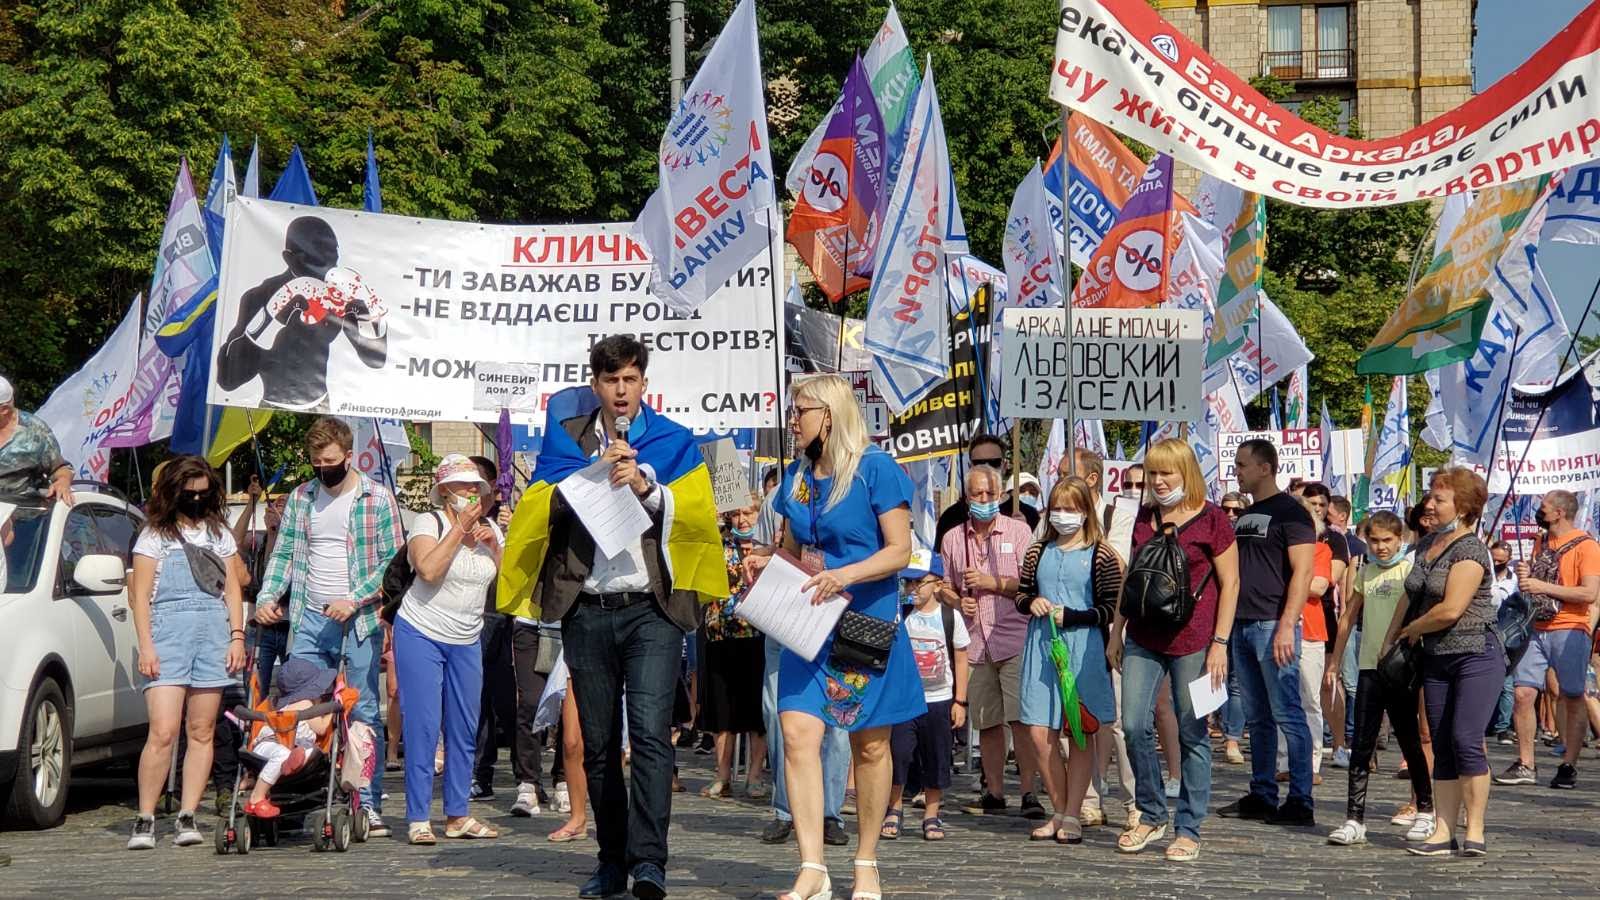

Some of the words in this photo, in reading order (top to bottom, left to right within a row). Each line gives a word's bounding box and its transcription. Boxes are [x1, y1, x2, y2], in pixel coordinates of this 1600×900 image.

[1184, 57, 1281, 134] Банк
[1291, 124, 1468, 163] Аркада,
[1057, 59, 1109, 103] чу
[1113, 88, 1221, 158] жити
[1234, 161, 1256, 181] в
[1273, 180, 1397, 203] своїй
[1177, 87, 1322, 177] більше
[1341, 142, 1476, 183] немає
[1490, 75, 1587, 142] сили
[1074, 125, 1115, 174] КМДА
[512, 236, 648, 264] КЛИЧК
[403, 267, 451, 289] -ТИ
[460, 271, 600, 293] ЗАВАЖАВ
[400, 298, 450, 320] -НЕ
[460, 302, 599, 326] ВІДДАЄШ
[587, 330, 776, 352] ІЕСТОРІВ?
[1089, 317, 1113, 339] НЕ
[1119, 318, 1180, 339] МОЛЧИ
[395, 357, 477, 379] -МОЖ
[1015, 341, 1181, 379] ЛЬВОВСКИЙ
[478, 373, 536, 385] СИНЕВИР
[486, 386, 509, 396] дом
[512, 386, 527, 396] 23
[701, 391, 776, 414] САМ?
[1374, 488, 1395, 505] 34
